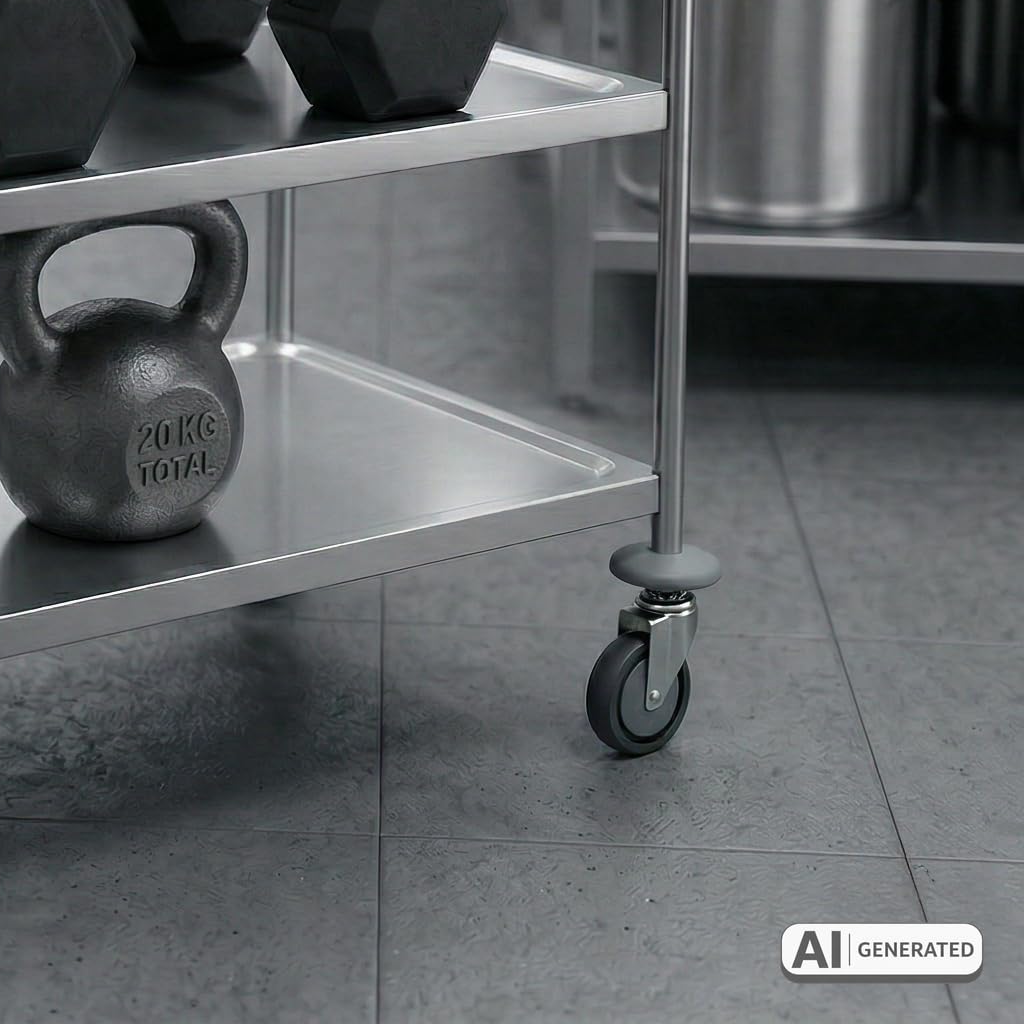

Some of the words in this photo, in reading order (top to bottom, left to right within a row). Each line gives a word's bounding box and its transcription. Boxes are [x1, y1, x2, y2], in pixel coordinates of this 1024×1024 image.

[137, 418, 172, 454] 20
[179, 410, 216, 447] KG
[137, 450, 219, 486] TOTAL
